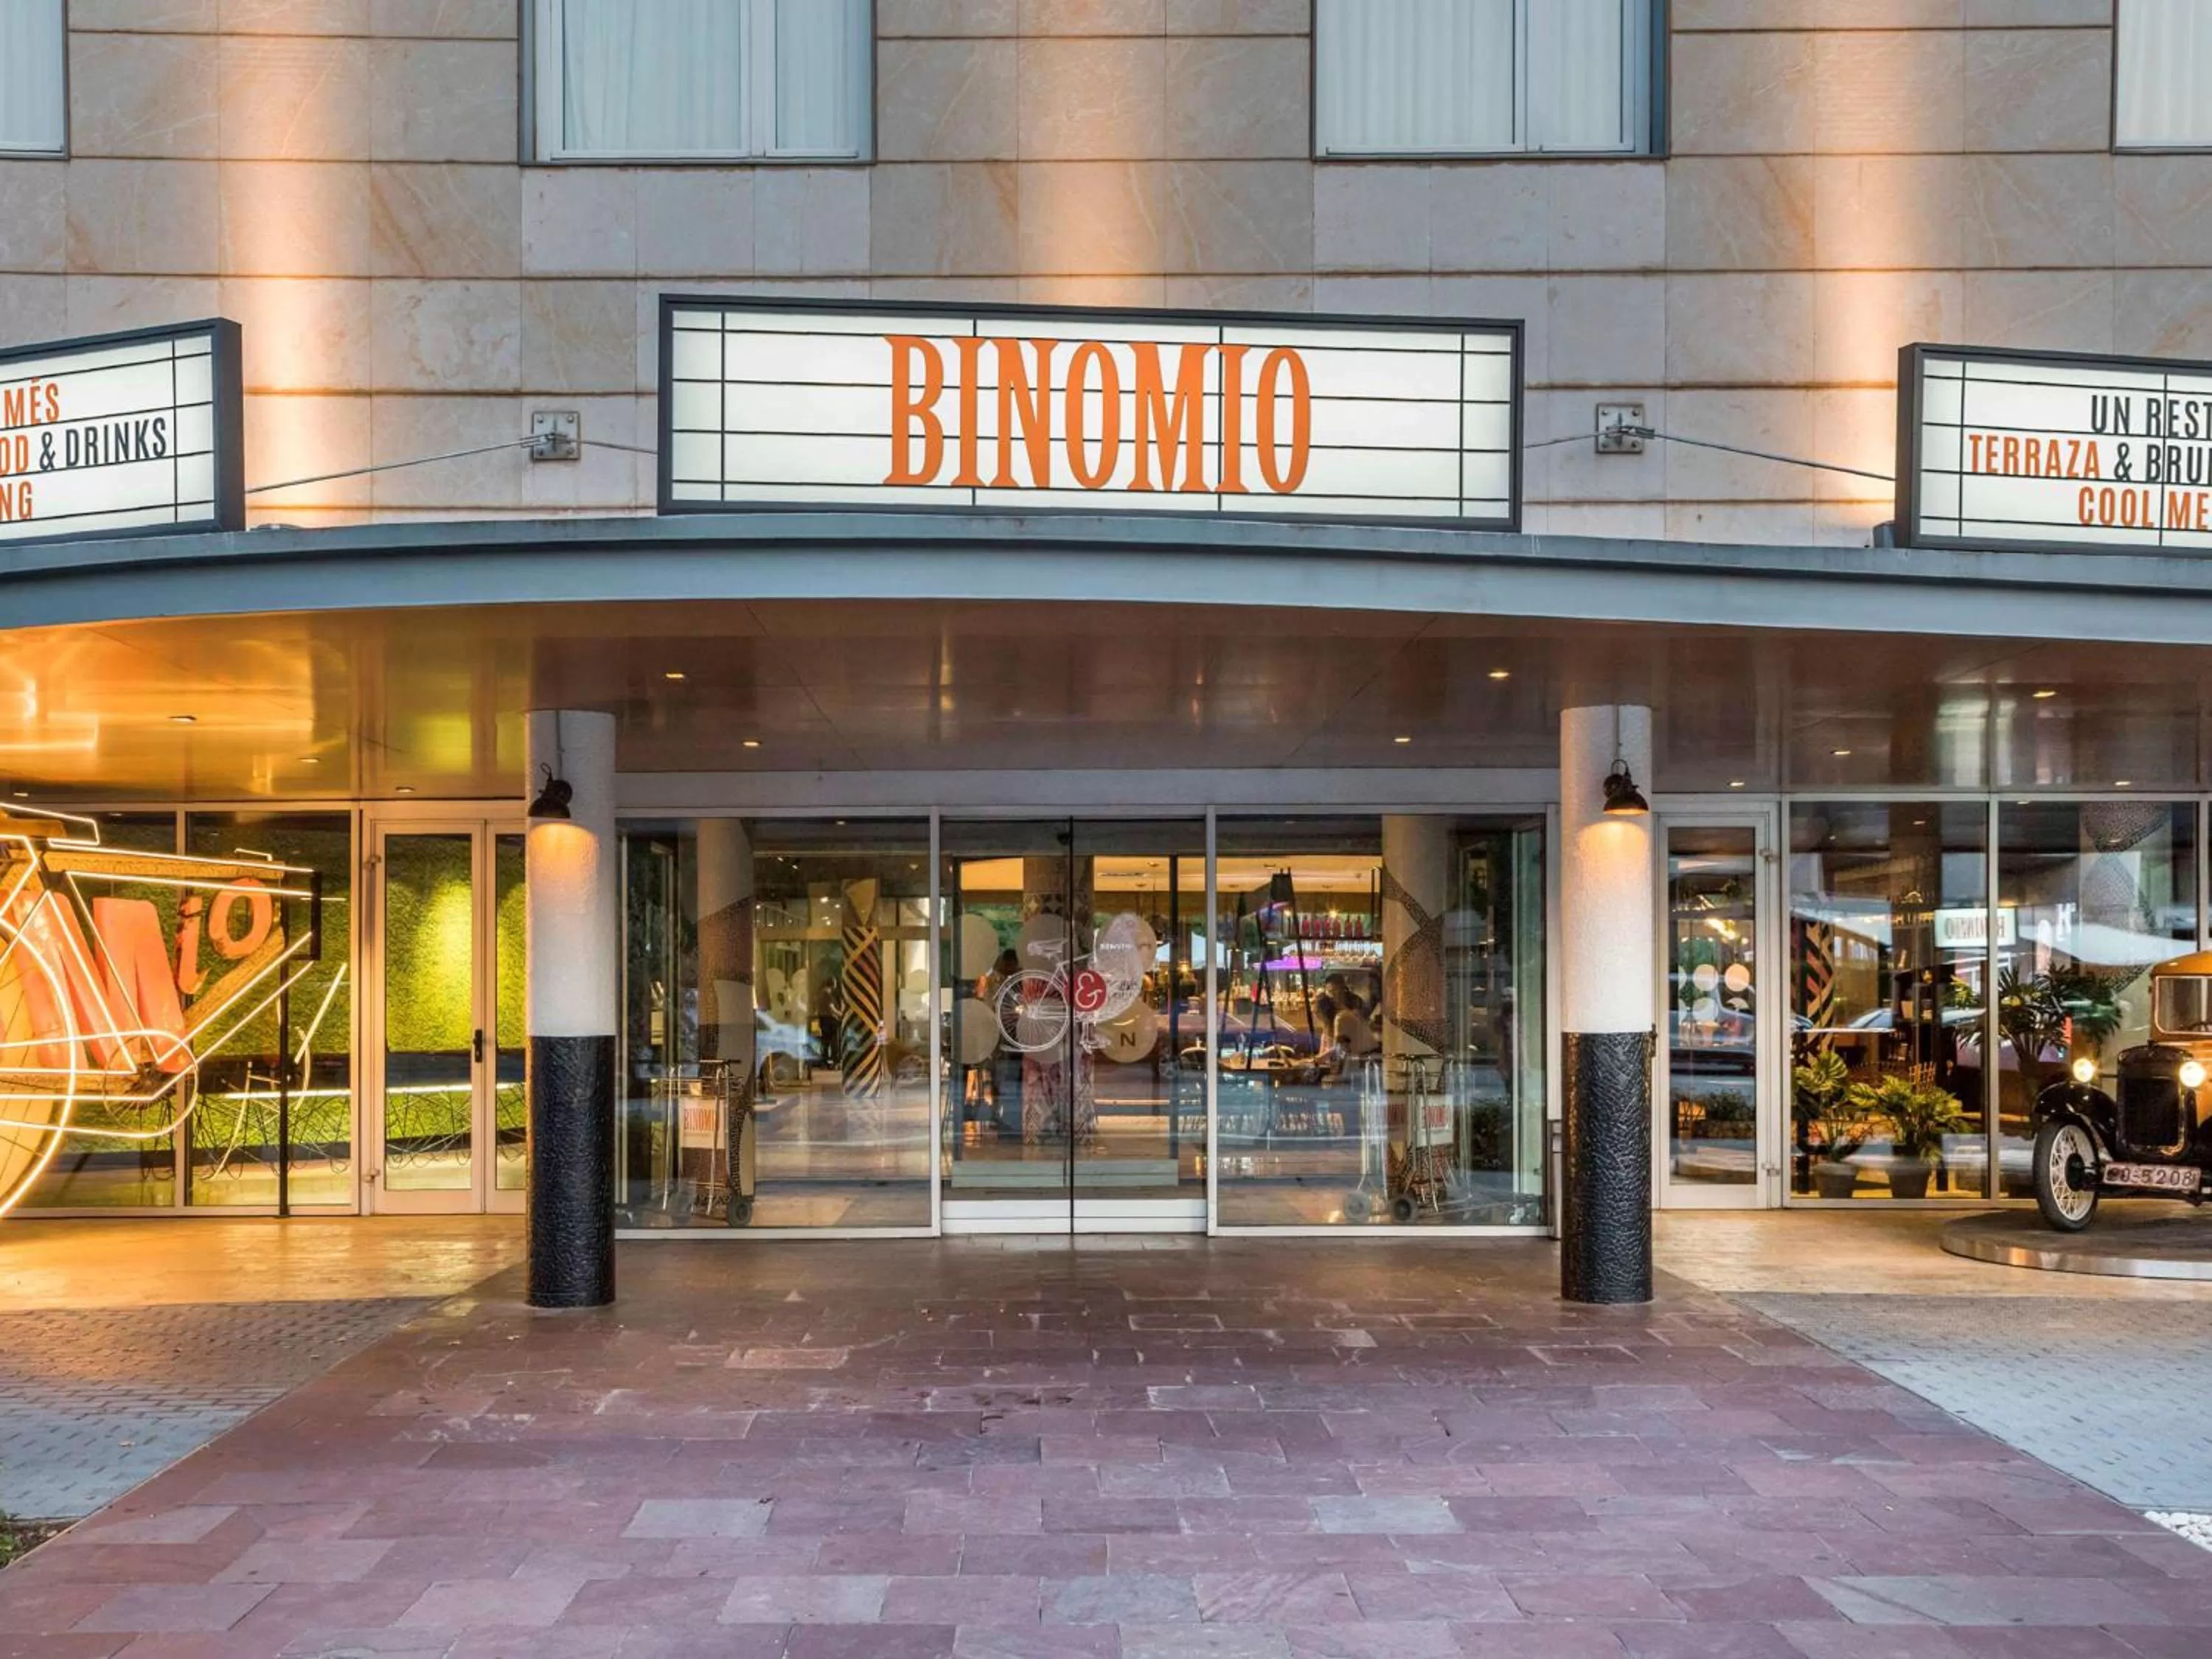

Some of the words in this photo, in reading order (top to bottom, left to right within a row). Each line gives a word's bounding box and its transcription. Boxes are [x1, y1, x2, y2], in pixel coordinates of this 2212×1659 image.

[4, 377, 60, 426] MÉS
[883, 335, 1311, 493] BINOMIO
[2091, 394, 2130, 435] UN
[39, 431, 56, 472] &
[66, 417, 167, 467] DRINKS
[1969, 434, 2101, 480] TERRAZA
[2114, 442, 2132, 481] &
[2079, 486, 2154, 528] COOL
